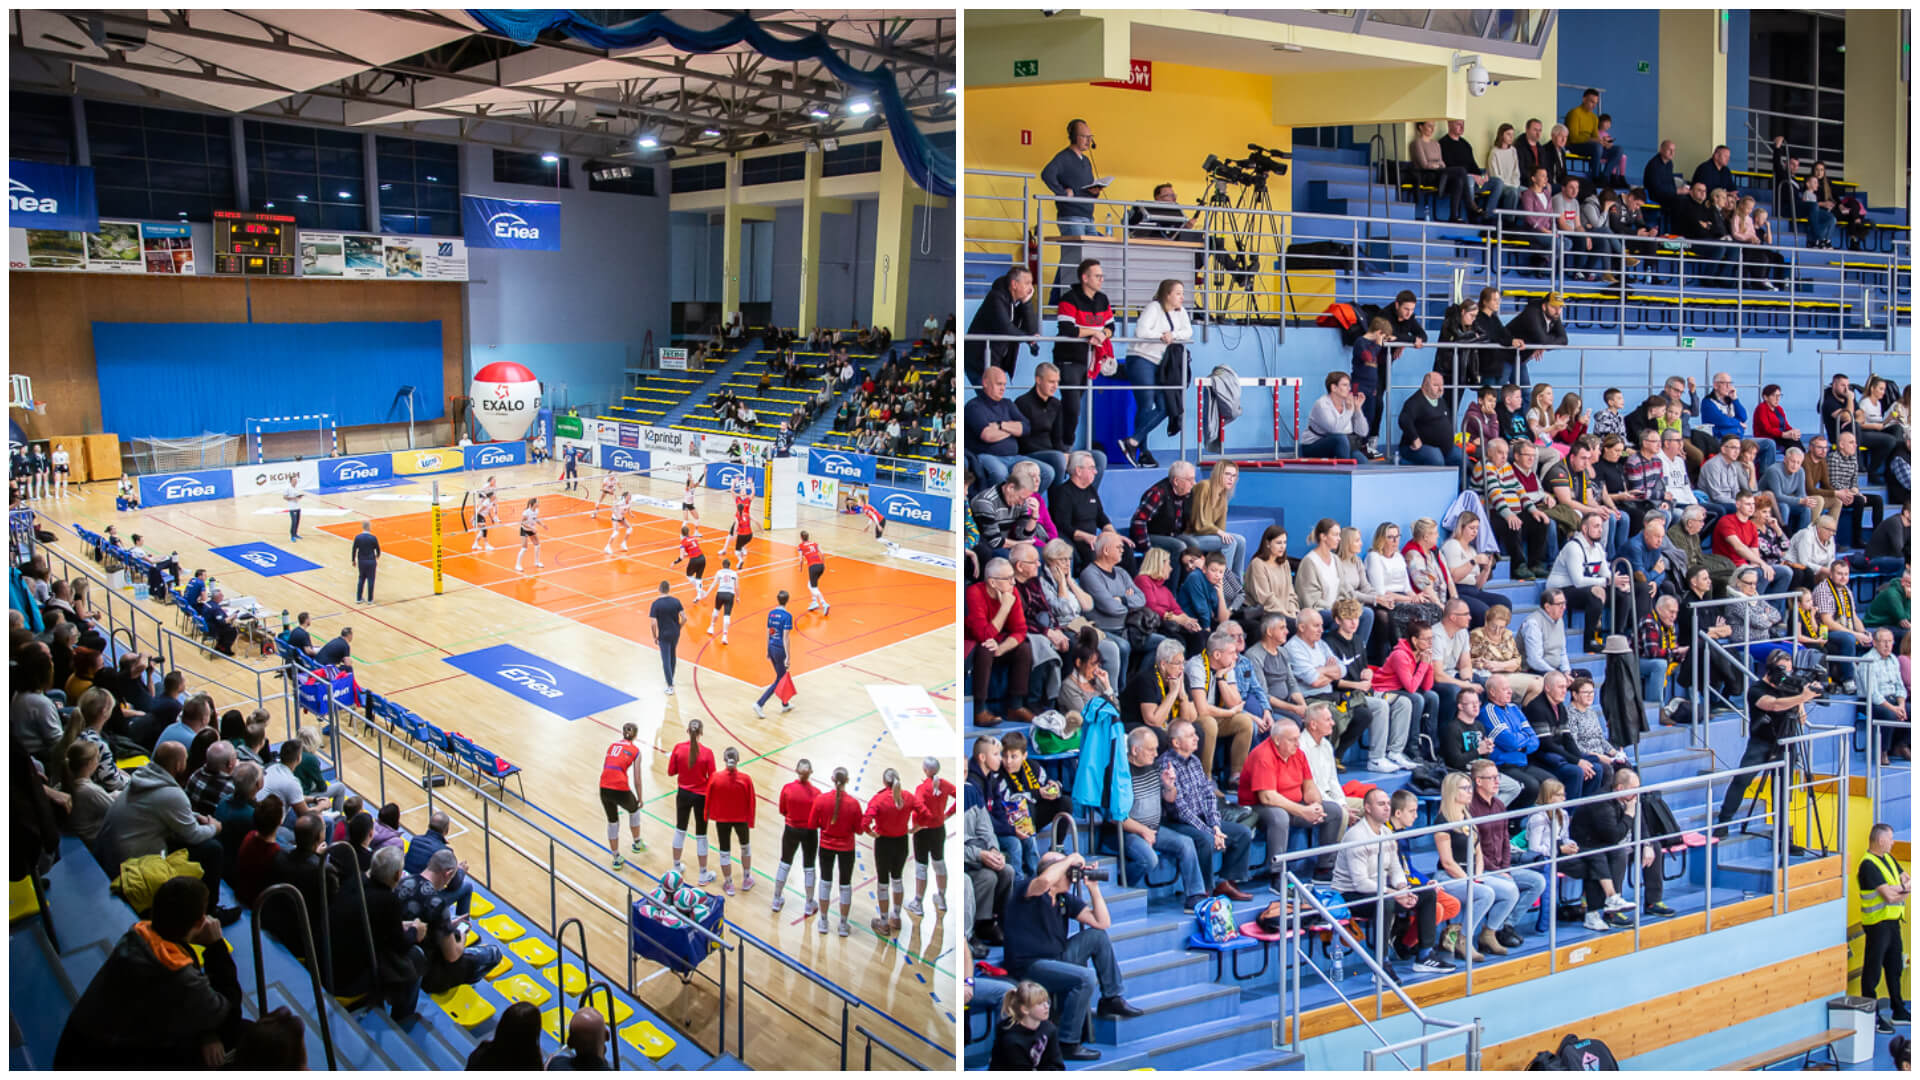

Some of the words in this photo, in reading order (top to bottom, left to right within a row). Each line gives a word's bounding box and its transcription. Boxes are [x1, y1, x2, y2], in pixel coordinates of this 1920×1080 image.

[9, 195, 58, 214] nea
[495, 222, 540, 239] Enea
[483, 400, 525, 411] EXALO
[481, 453, 514, 465] Enea
[614, 456, 640, 470] Enea
[340, 466, 378, 480] Enea
[825, 461, 862, 478] Enea
[166, 485, 216, 499] Enea
[888, 502, 932, 521] Enea
[497, 668, 564, 698] Enea
